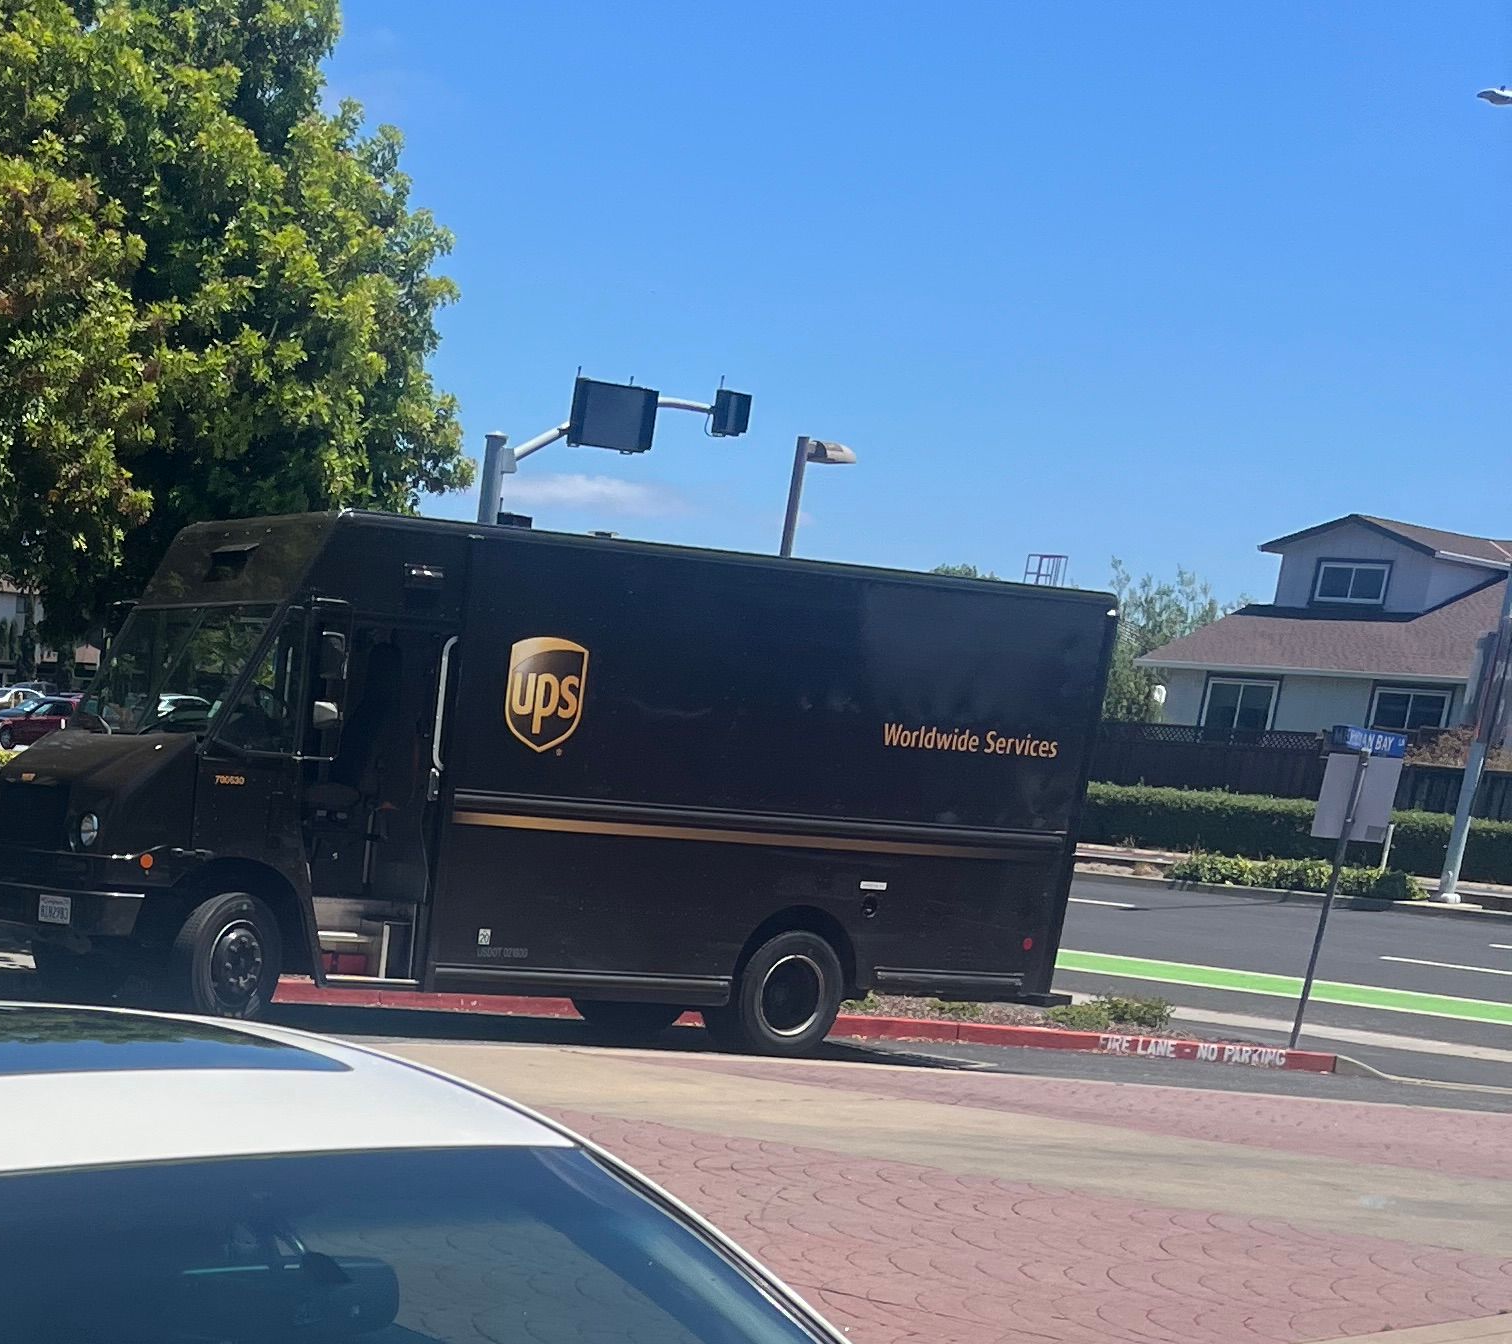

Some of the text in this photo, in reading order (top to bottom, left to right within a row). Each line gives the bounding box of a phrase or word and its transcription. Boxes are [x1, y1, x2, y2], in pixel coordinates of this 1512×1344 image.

[511, 672, 580, 734] ups
[883, 723, 1059, 758] Worldwide Services
[1334, 727, 1375, 750] MEIAN
[1375, 734, 1395, 751] BAY
[1099, 1034, 1130, 1055] FIRE
[1136, 1036, 1177, 1058] LANE
[1196, 1043, 1218, 1061] NO
[1223, 1044, 1287, 1066] PARKING
